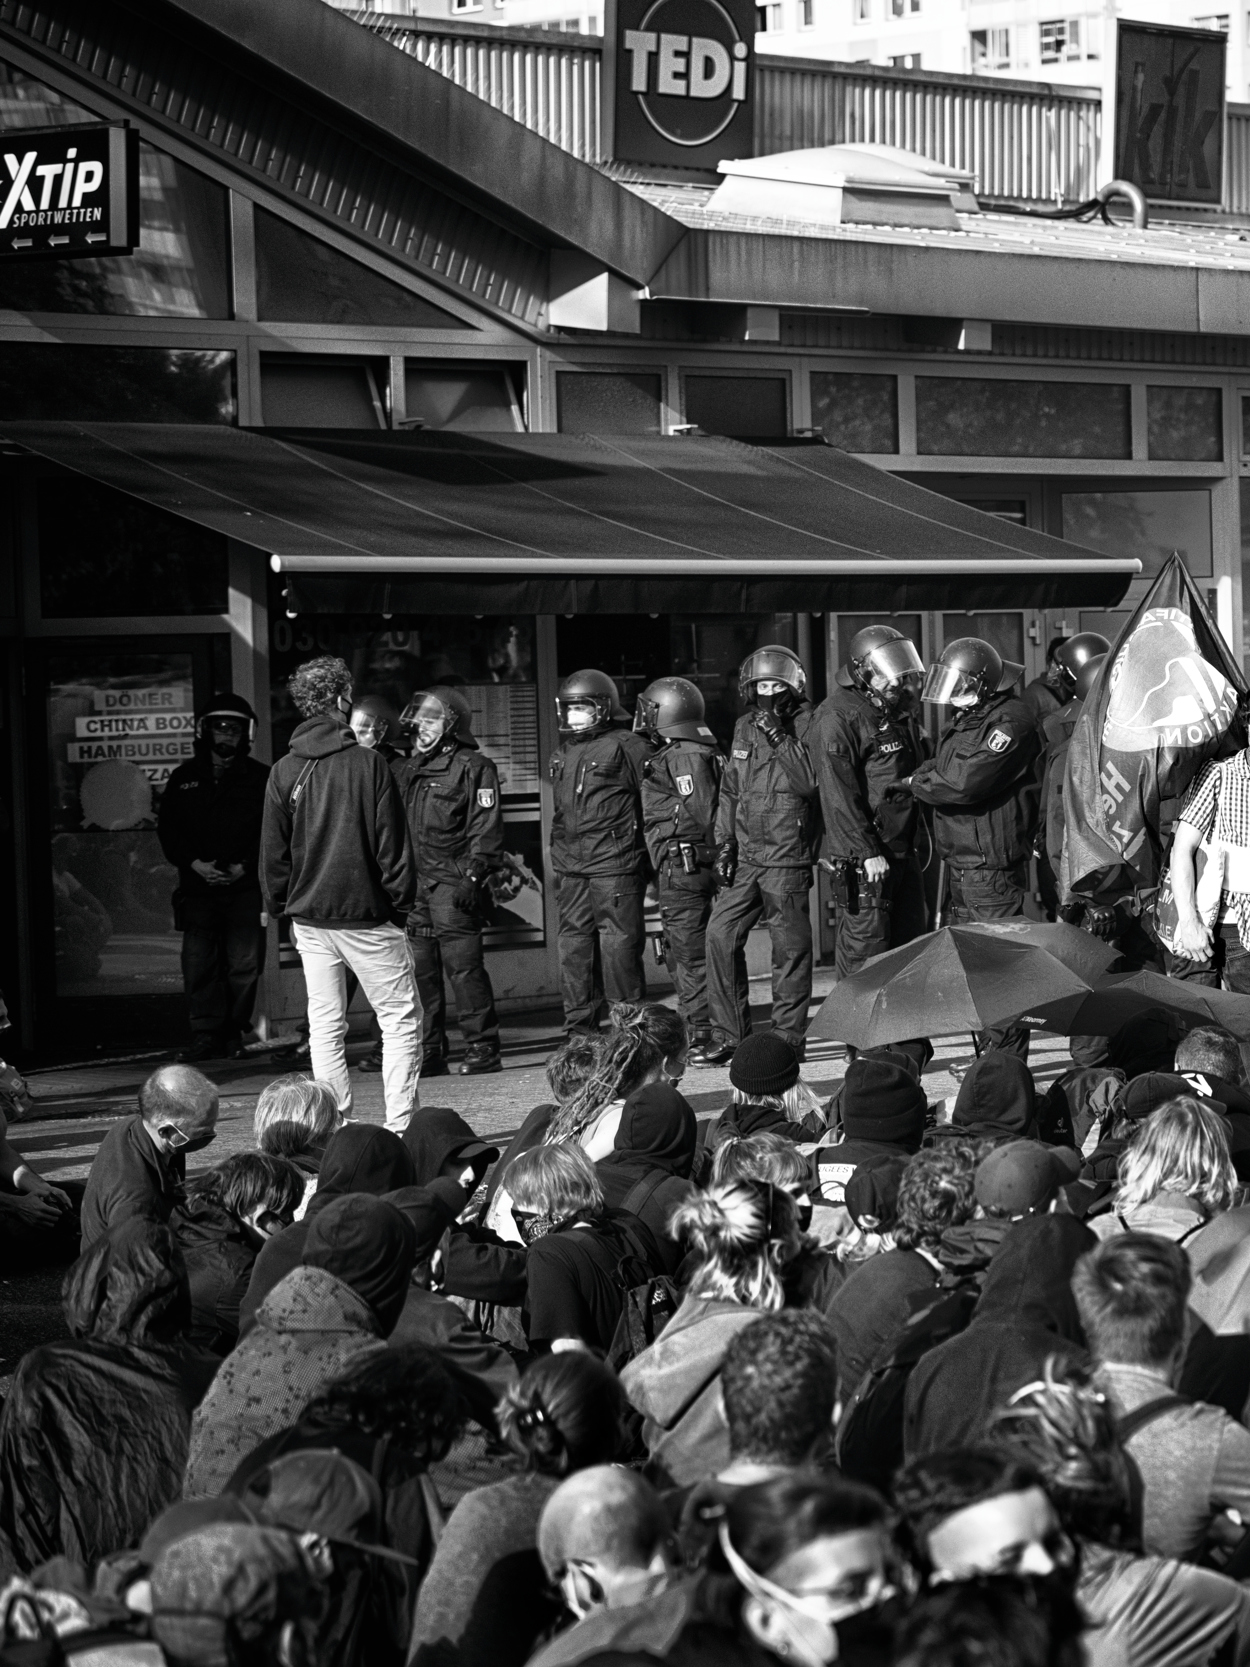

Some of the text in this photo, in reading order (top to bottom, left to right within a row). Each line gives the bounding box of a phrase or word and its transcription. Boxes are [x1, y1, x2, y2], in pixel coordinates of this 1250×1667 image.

[624, 29, 748, 101] TEDi
[13, 207, 102, 228] SPORTWETTEN
[105, 691, 174, 708] DÖNER
[86, 715, 195, 734] CHINA BOX
[78, 741, 195, 760] HAMBURGE
